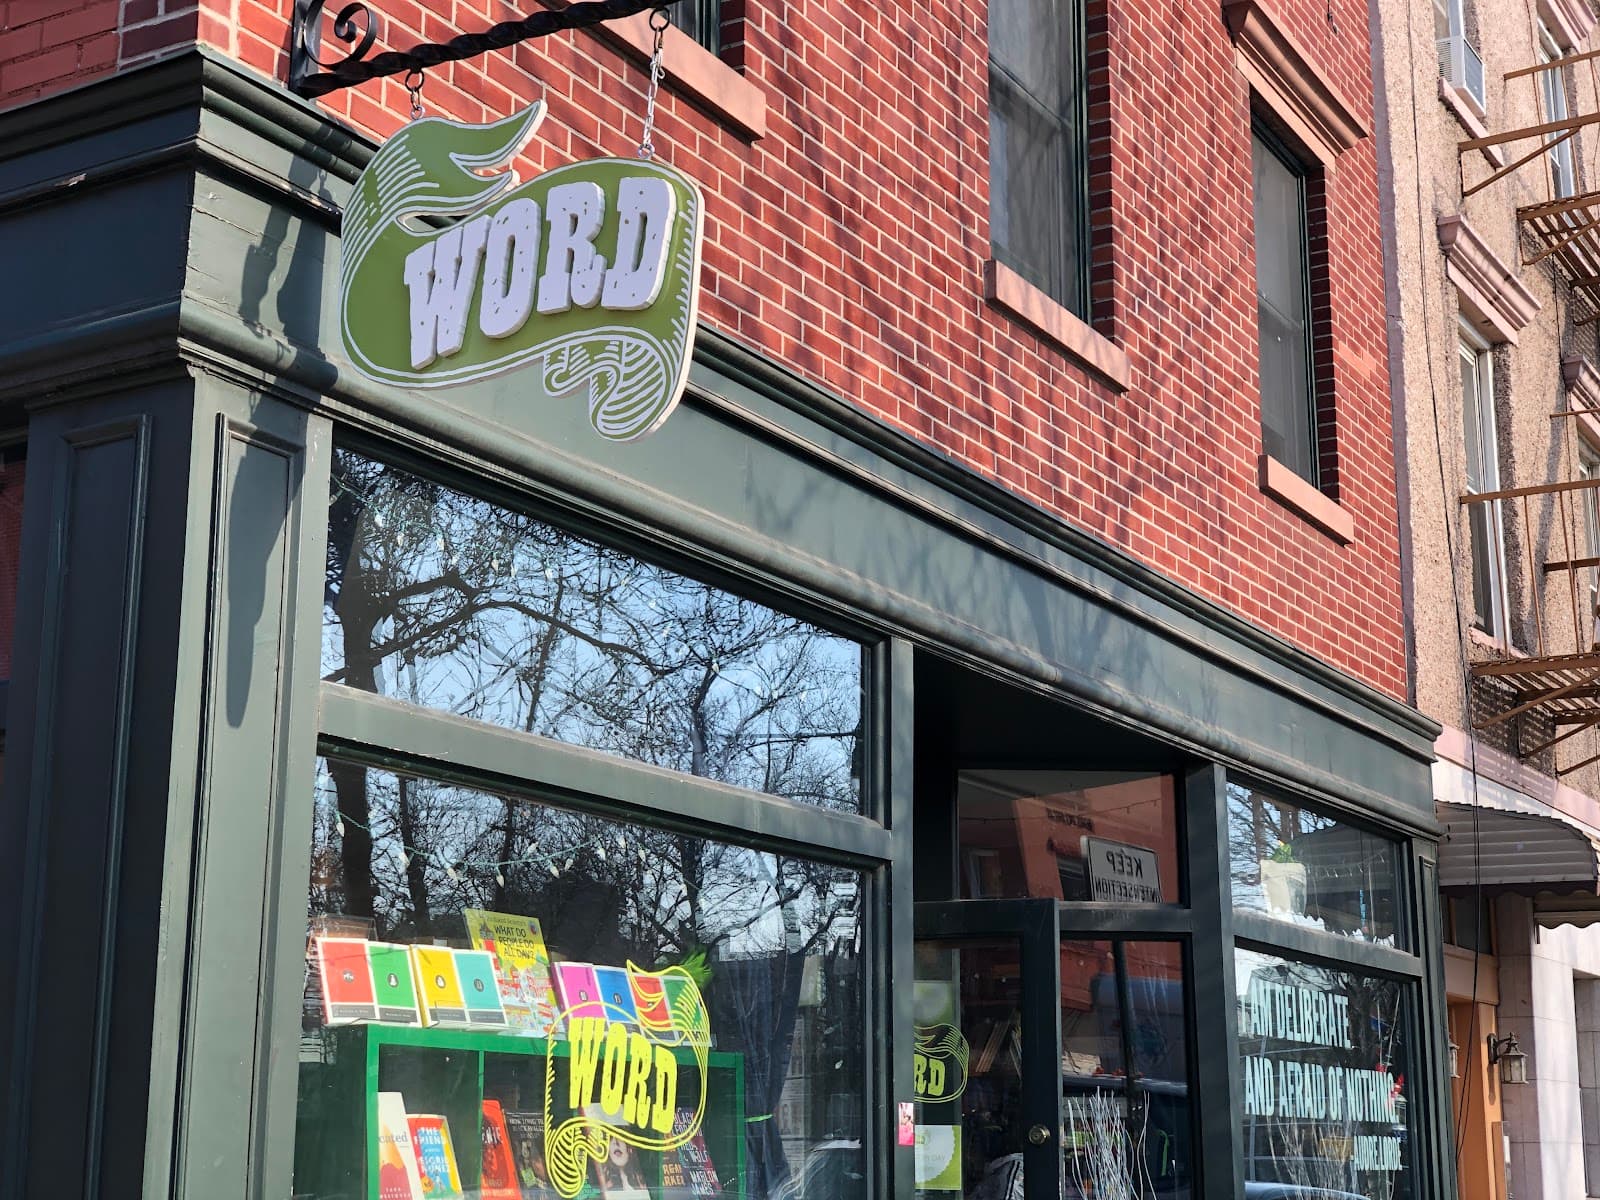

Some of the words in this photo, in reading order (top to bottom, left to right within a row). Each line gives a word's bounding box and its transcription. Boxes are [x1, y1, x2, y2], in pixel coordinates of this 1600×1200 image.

[404, 177, 677, 370] WORD
[495, 925, 514, 936] WHAT
[516, 928, 526, 938] DO
[1250, 977, 1273, 1037] AM
[1275, 983, 1351, 1049] DELIBERATE
[568, 1016, 678, 1133] WORD
[914, 1054, 945, 1096] RD
[1245, 1056, 1275, 1117] AND
[1279, 1060, 1326, 1119] AFRAID
[1328, 1066, 1344, 1121] OF
[377, 1131, 408, 1144] cated
[1379, 1135, 1403, 1171] LORDE
